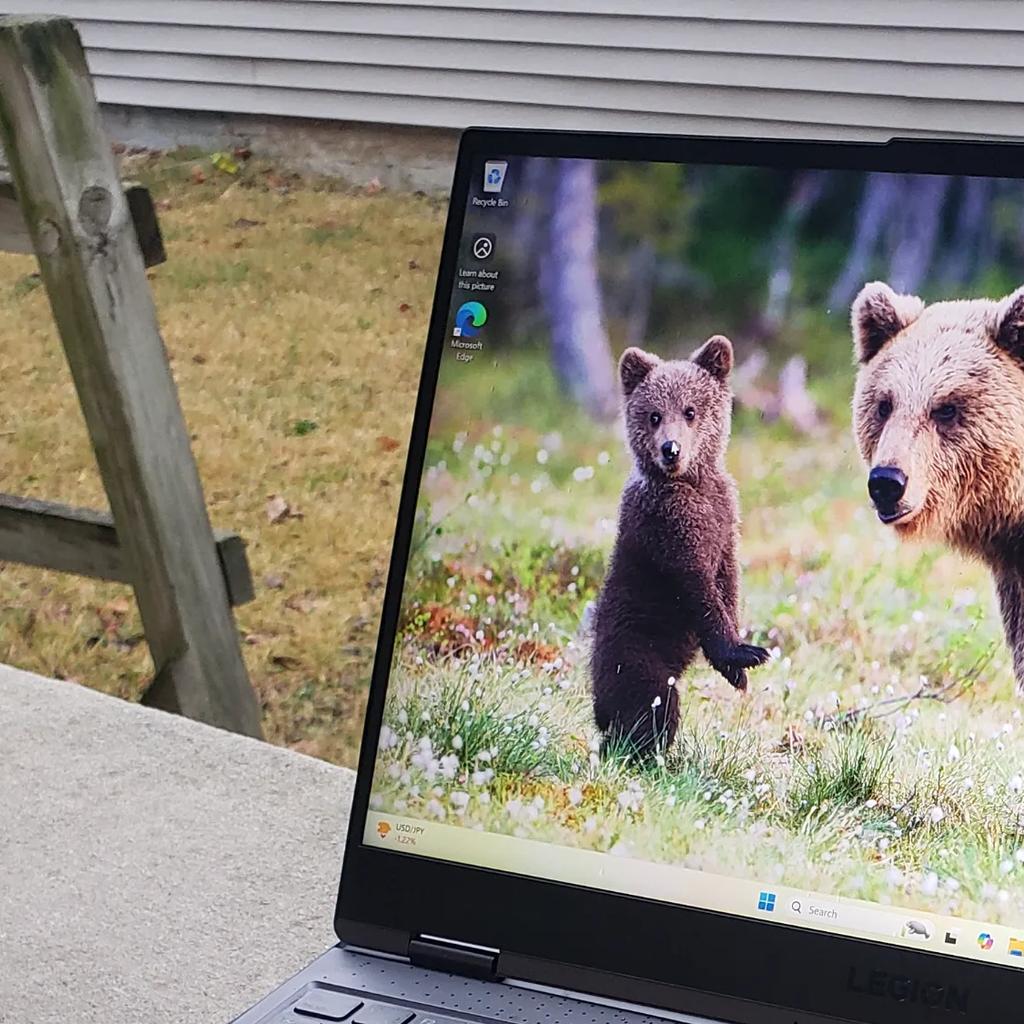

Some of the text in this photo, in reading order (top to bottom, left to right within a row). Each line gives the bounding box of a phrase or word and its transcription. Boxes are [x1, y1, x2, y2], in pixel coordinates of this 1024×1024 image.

[472, 197, 509, 207] Recycle Bin
[459, 268, 499, 279] Learn about
[458, 281, 495, 292] this picture
[451, 340, 483, 363] Microsoft Edge
[396, 823, 424, 835] USD/JPY
[808, 905, 838, 919] Search
[847, 966, 970, 1016] LEGION
